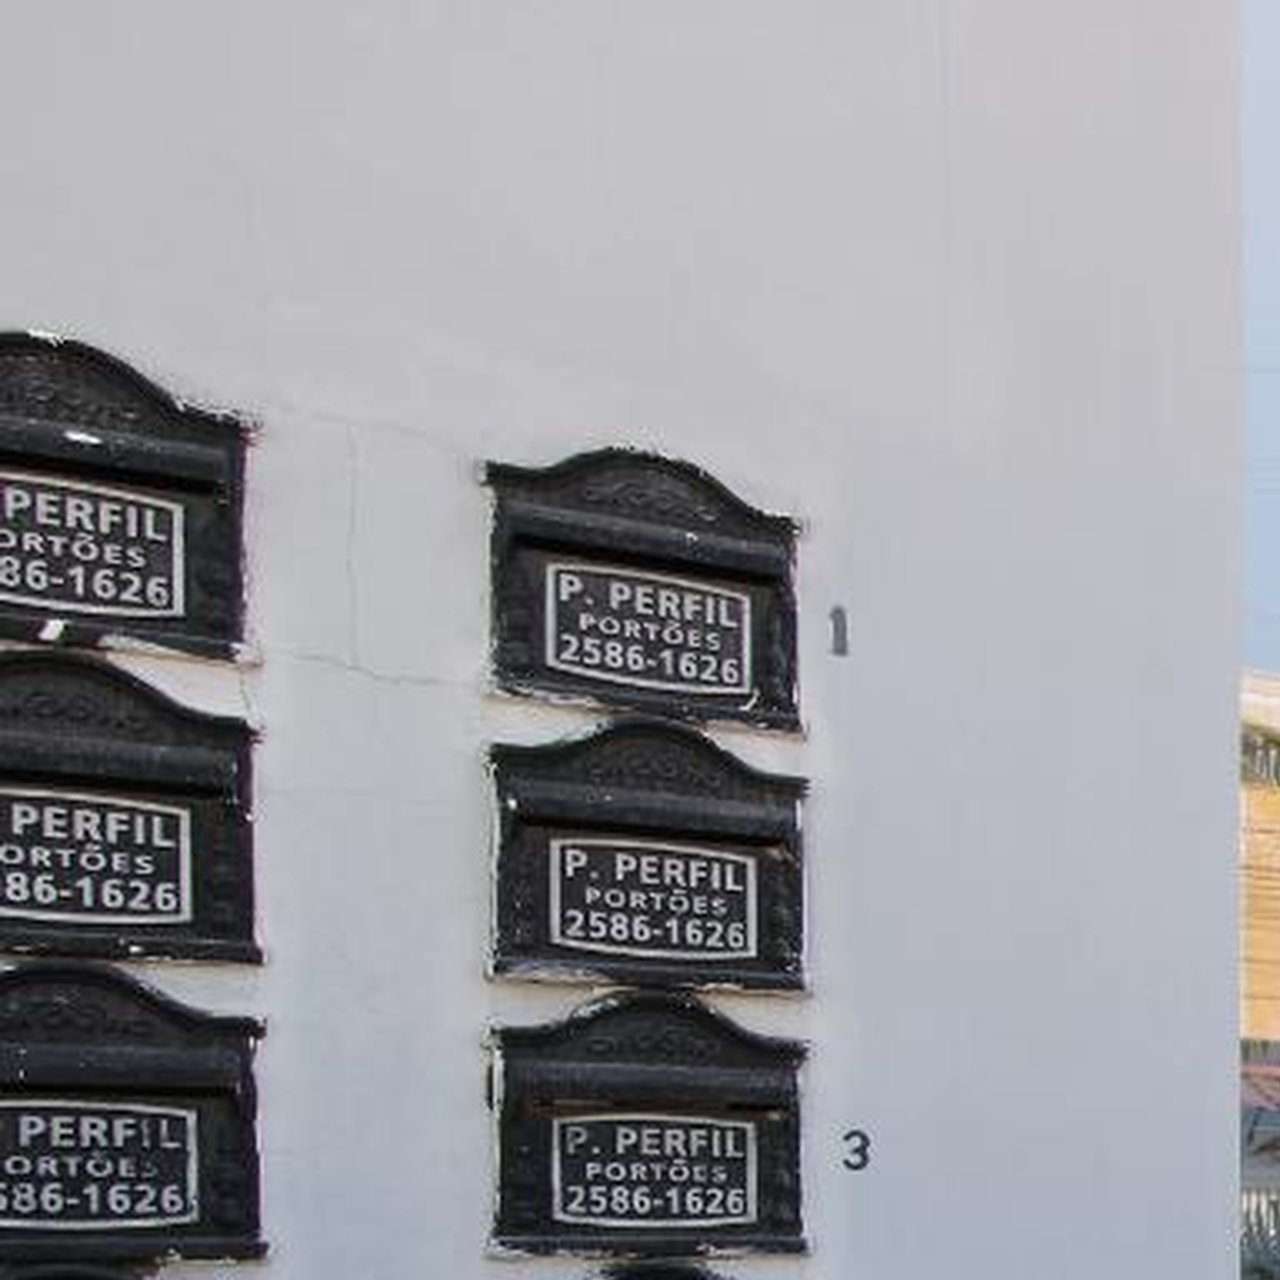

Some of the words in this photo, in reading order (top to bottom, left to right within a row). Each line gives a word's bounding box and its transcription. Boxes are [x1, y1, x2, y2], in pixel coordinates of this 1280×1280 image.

[4, 487, 167, 541] PERFIL
[0, 529, 146, 568] ORTÕES
[0, 555, 169, 607] 86-1626
[559, 572, 593, 605] P.
[610, 582, 737, 627] PERFIL
[579, 612, 721, 651] PORTÕES
[829, 604, 849, 657] 1
[560, 634, 739, 684] 2586-1626
[12, 802, 176, 847] PERFIL
[0, 843, 154, 875] ORTÕES
[565, 850, 598, 879] P.
[616, 852, 744, 892] PERFIL
[5, 872, 178, 911] 86-1626
[585, 886, 728, 916] PORTÕES
[565, 909, 744, 949] 2586-1626
[19, 1115, 181, 1148] PERFIL
[566, 1126, 600, 1155] P.
[616, 1127, 744, 1158] PERFIL
[842, 1130, 871, 1171] 3
[5, 1151, 159, 1178] ORTÕES
[586, 1159, 728, 1183] PORTÕES
[0, 1183, 184, 1214] 86-1626
[566, 1186, 745, 1215] 2586-1626
